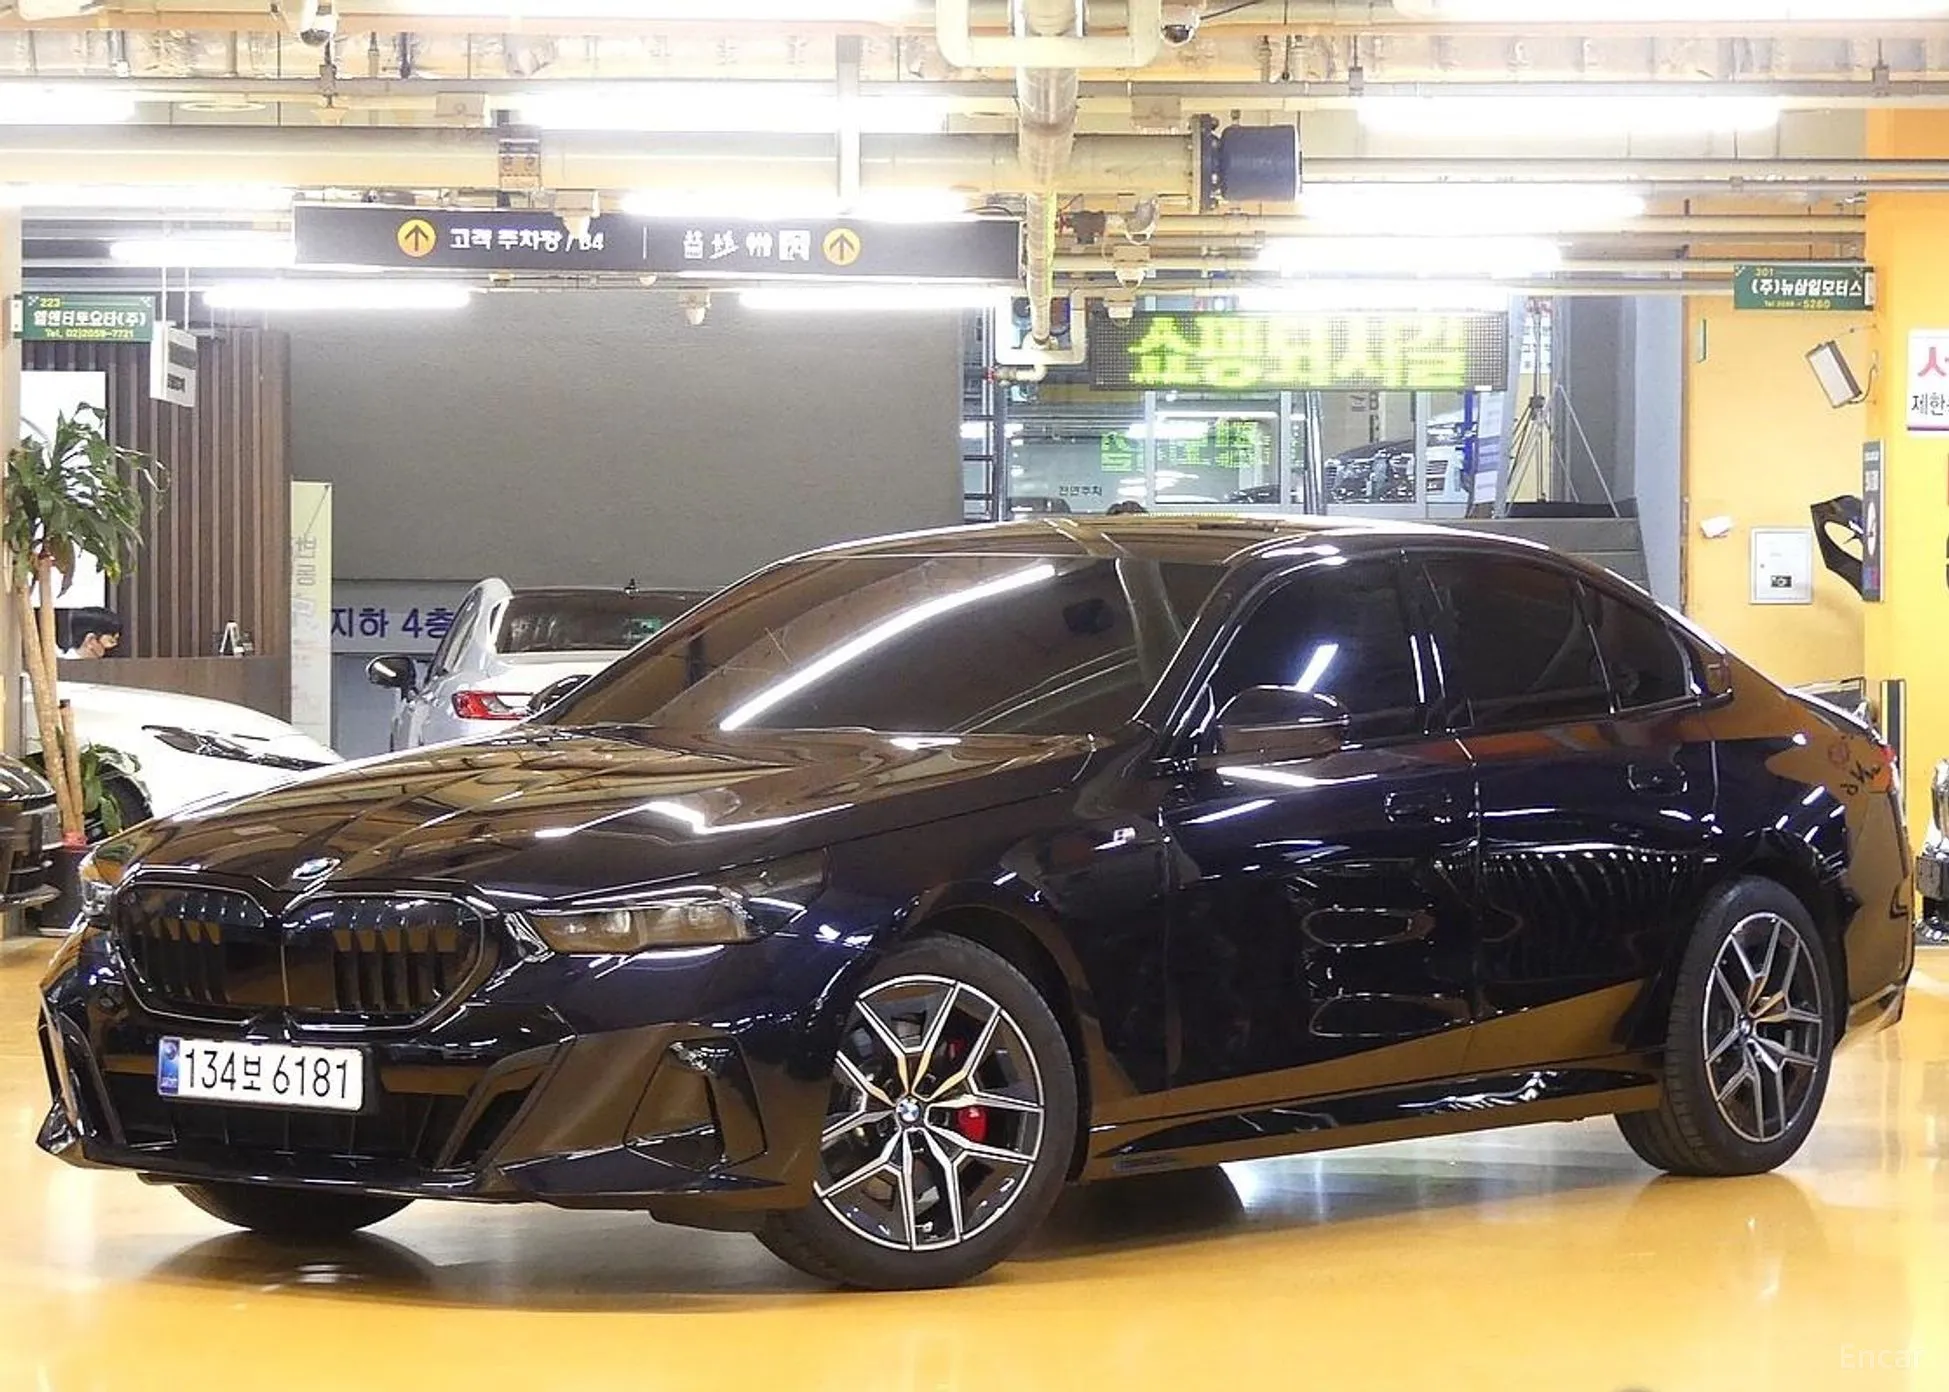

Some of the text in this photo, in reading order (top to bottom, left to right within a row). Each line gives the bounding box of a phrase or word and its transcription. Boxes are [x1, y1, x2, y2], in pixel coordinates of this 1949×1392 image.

[450, 228, 493, 250] 고객
[497, 229, 563, 252] 주차장
[1754, 267, 1774, 277] 301
[1751, 278, 1862, 297] (주)뉴삼일모터스
[39, 298, 61, 308] 223
[1911, 391, 1949, 416] 제한
[332, 606, 455, 639] 지하 4층
[185, 1048, 348, 1100] 134보 6181
